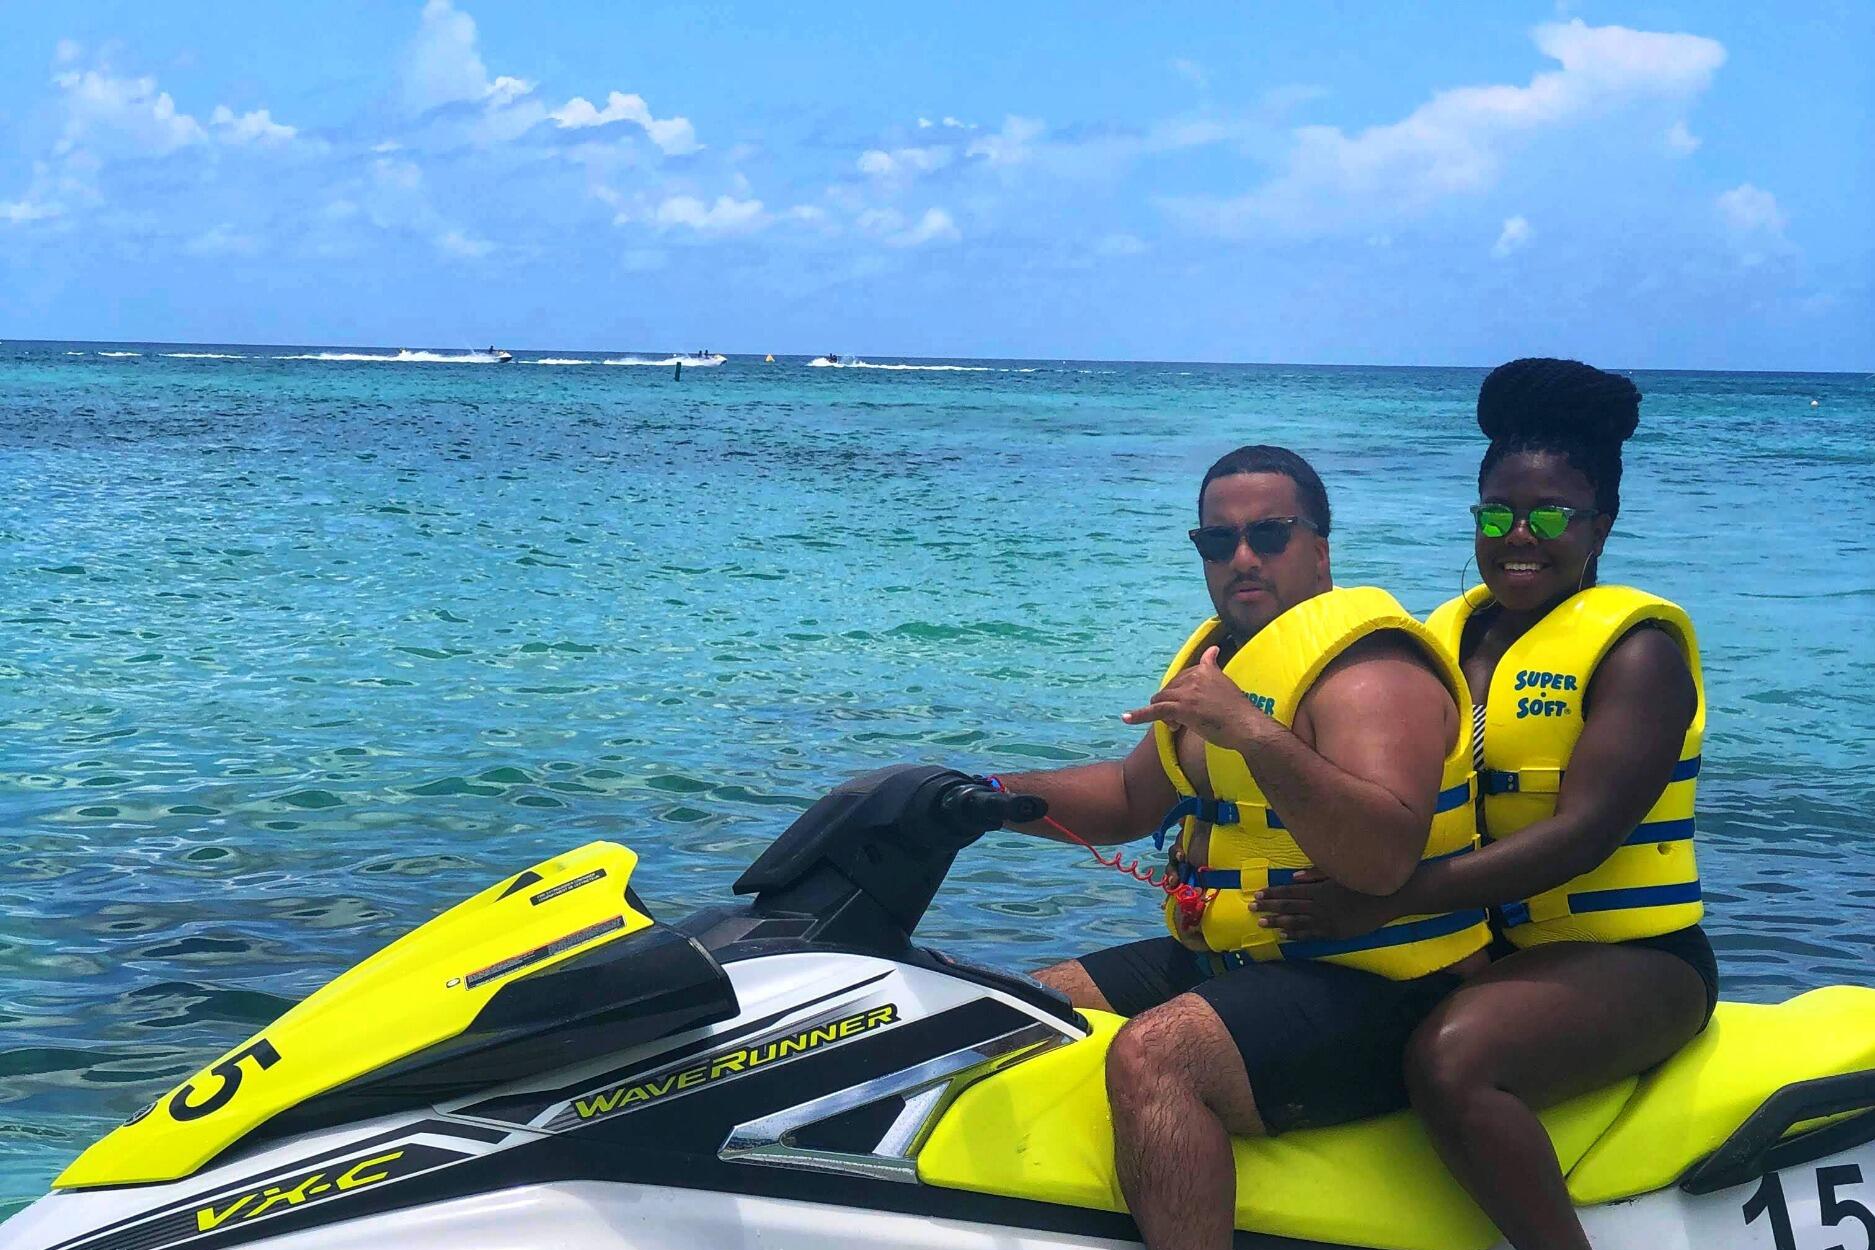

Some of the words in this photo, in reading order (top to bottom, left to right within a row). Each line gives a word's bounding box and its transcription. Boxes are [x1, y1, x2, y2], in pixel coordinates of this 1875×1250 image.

[1241, 691, 1276, 715] PER
[1514, 670, 1577, 691] SUPER
[575, 1004, 896, 1118] WAVERUNNER
[196, 1151, 405, 1232] VX-C
